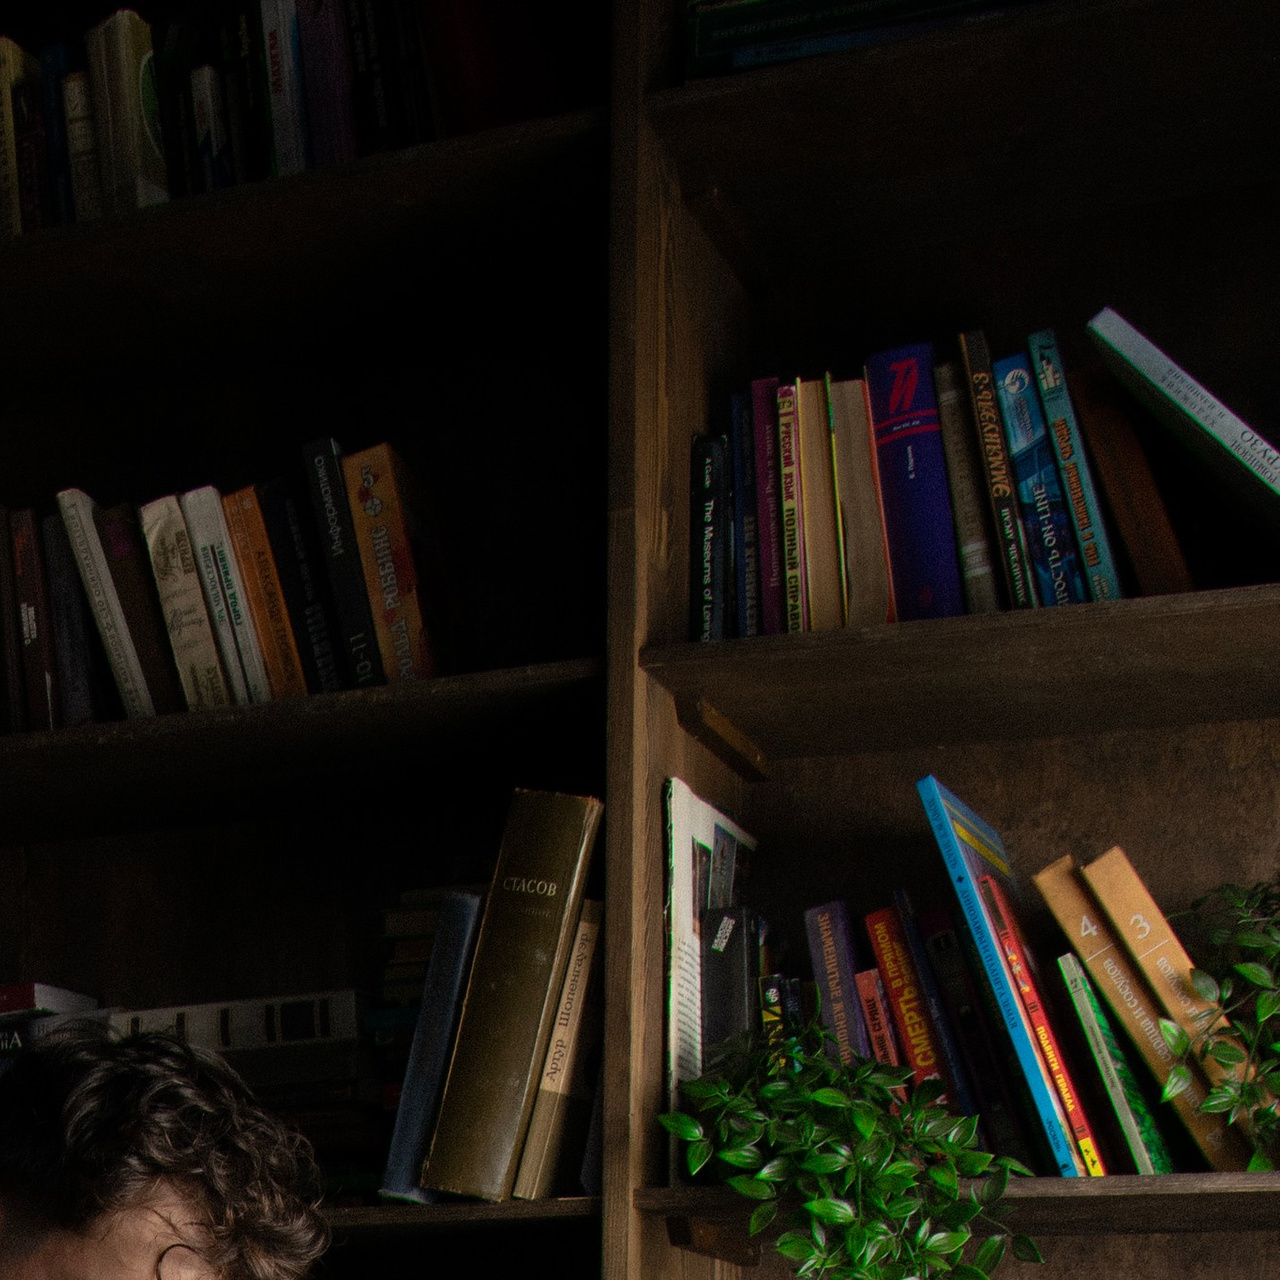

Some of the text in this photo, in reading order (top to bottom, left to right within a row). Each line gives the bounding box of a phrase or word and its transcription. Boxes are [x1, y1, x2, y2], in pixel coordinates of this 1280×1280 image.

[781, 421, 793, 468] РУССКИЙ
[1237, 427, 1280, 471] РУЗО
[783, 472, 794, 501] ЯЗЫК
[702, 526, 713, 584] Museums
[784, 507, 797, 570] ПОЛНЫЙ
[502, 876, 557, 896] СТАСОВ
[1078, 913, 1099, 939] 4
[1126, 912, 1151, 939] 3
[816, 912, 841, 999] ЗНАМЕНИТЫЕ
[982, 953, 1006, 998] ПЛАНЕТА
[873, 921, 937, 1068] СМЕРТЬ В ПРЯМОМ
[1099, 955, 1141, 1010] сосудов
[544, 931, 593, 1083] Артур Шопенгауэр
[864, 996, 882, 1032] СЕРДЦЕ
[1035, 1025, 1076, 1112] ПОДВИГИ ГЕРАКЛА
